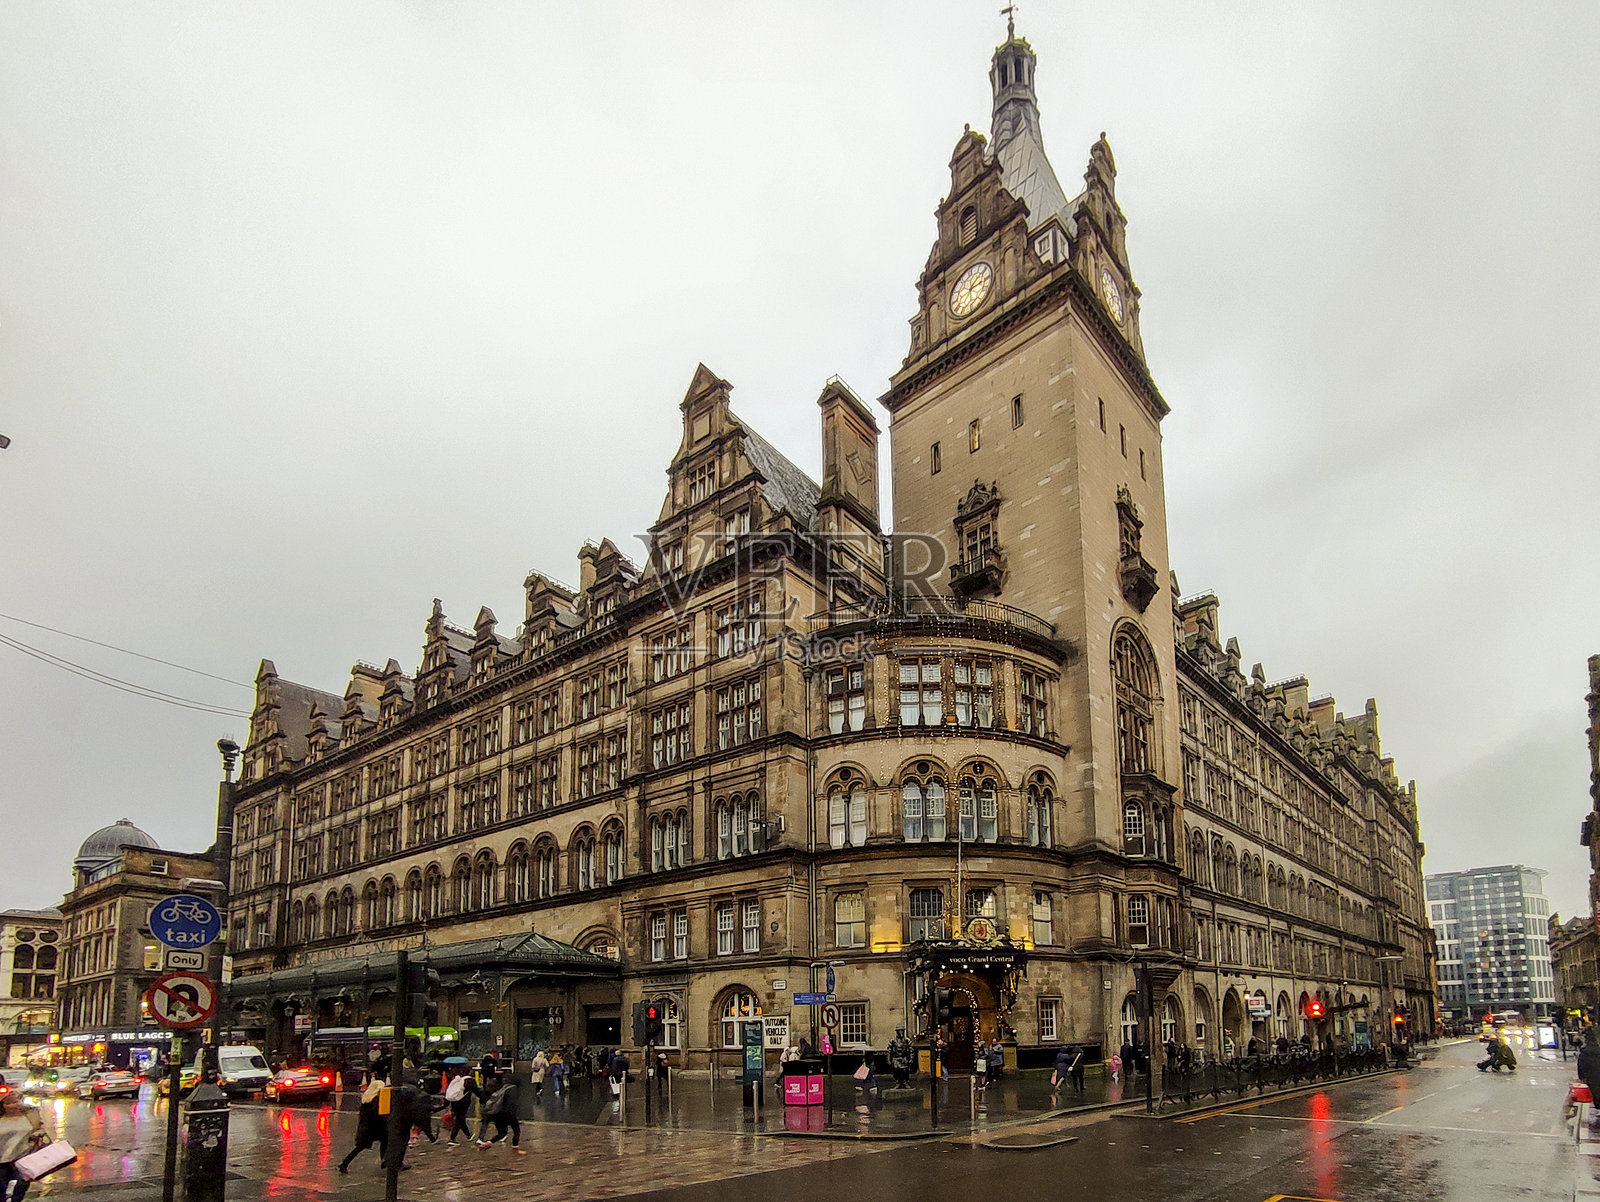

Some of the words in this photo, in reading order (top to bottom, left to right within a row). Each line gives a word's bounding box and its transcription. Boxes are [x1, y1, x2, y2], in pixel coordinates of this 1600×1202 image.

[165, 928, 206, 943] taxi
[172, 955, 199, 966] Only
[967, 955, 989, 963] Grand
[765, 1018, 788, 1027] OUTGOING
[111, 1032, 136, 1040] BLUE
[765, 1027, 787, 1036] VEHICLES
[770, 1037, 783, 1045] ONLY
